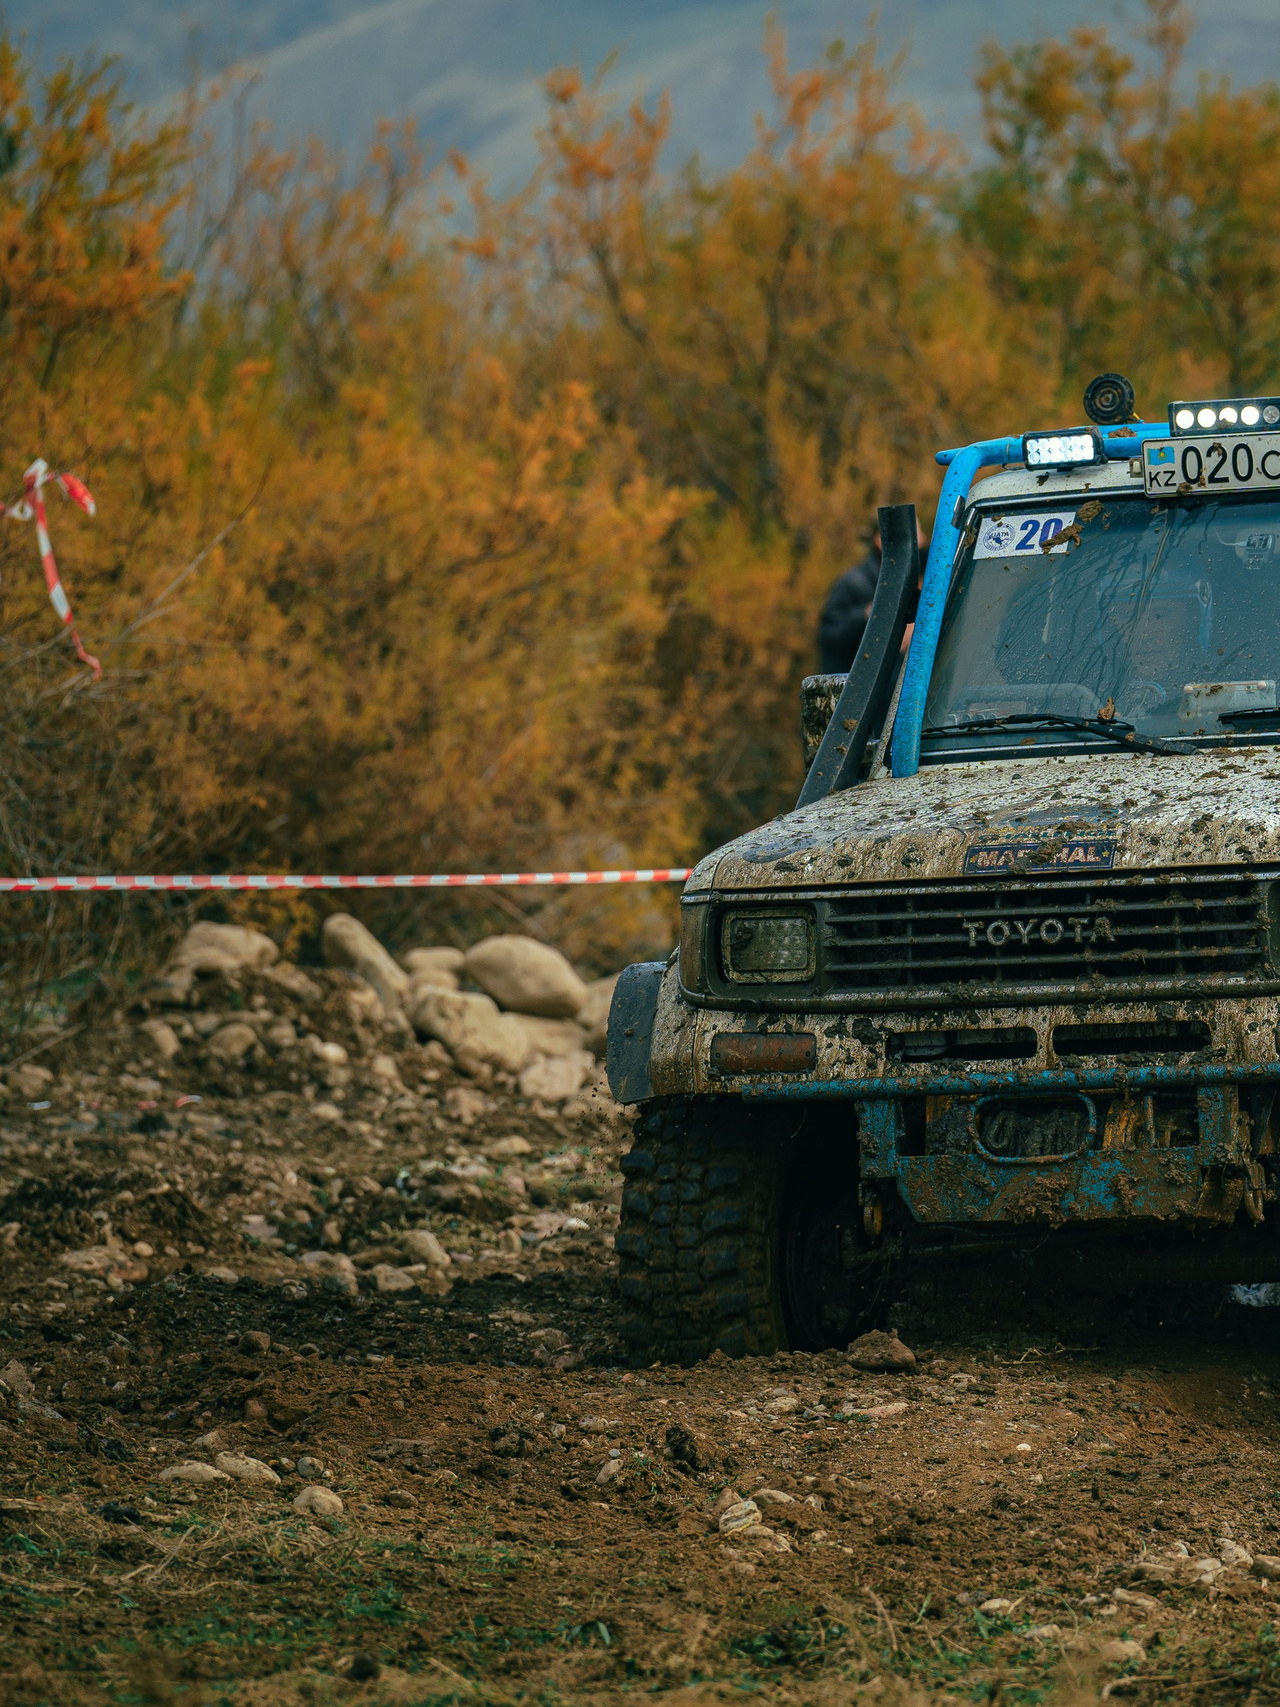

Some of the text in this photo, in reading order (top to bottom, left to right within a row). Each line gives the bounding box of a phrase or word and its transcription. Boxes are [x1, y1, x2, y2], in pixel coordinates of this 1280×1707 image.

[1149, 470, 1177, 488] KZ
[1015, 517, 1063, 550] 20
[976, 846, 1102, 868] MAHAL
[962, 916, 1116, 947] TOYOTA
